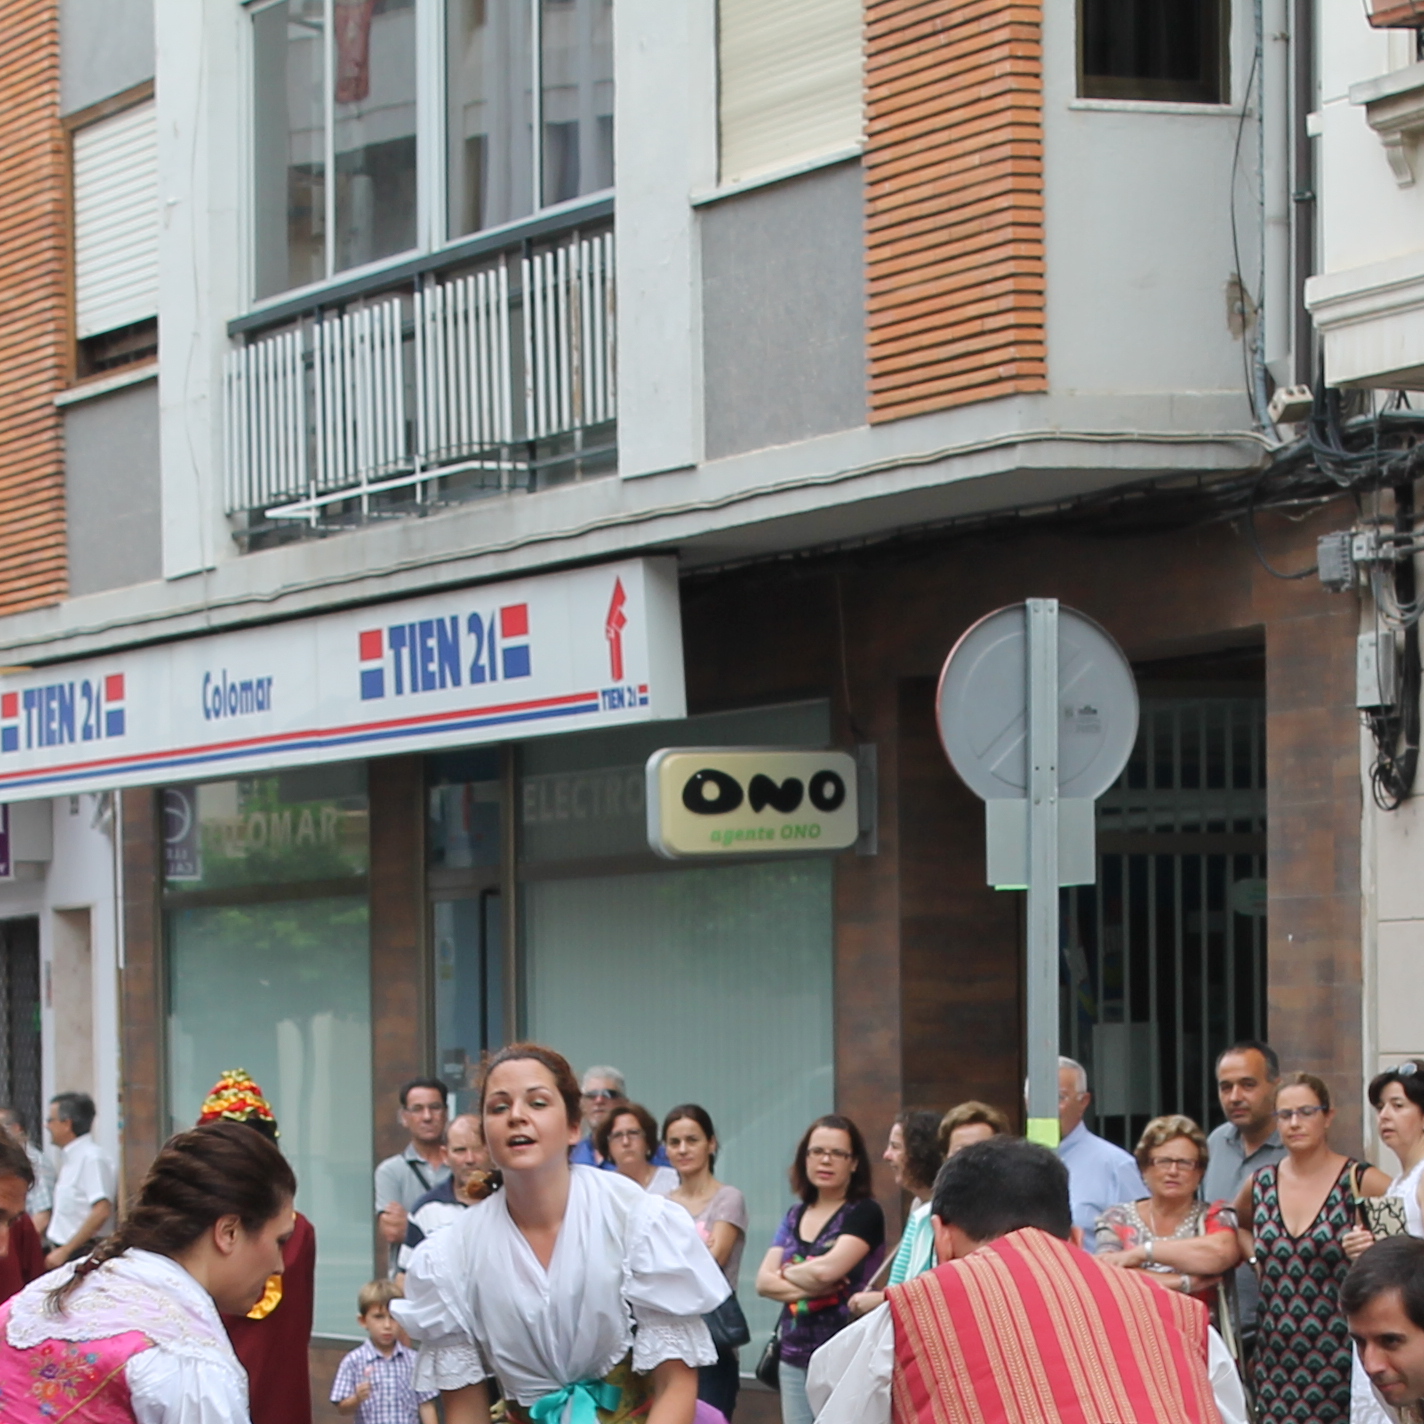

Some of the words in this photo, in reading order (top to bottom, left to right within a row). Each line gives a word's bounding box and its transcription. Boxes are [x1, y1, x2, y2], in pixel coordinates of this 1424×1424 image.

[388, 614, 463, 696] TIEN
[467, 608, 498, 686] 21
[23, 681, 76, 750] TIEN
[80, 679, 102, 741] 21
[202, 669, 274, 721] Colomar
[600, 687, 625, 711] TIEN
[682, 768, 846, 815] ONO
[709, 825, 775, 845] agente
[780, 823, 822, 840] ONO
